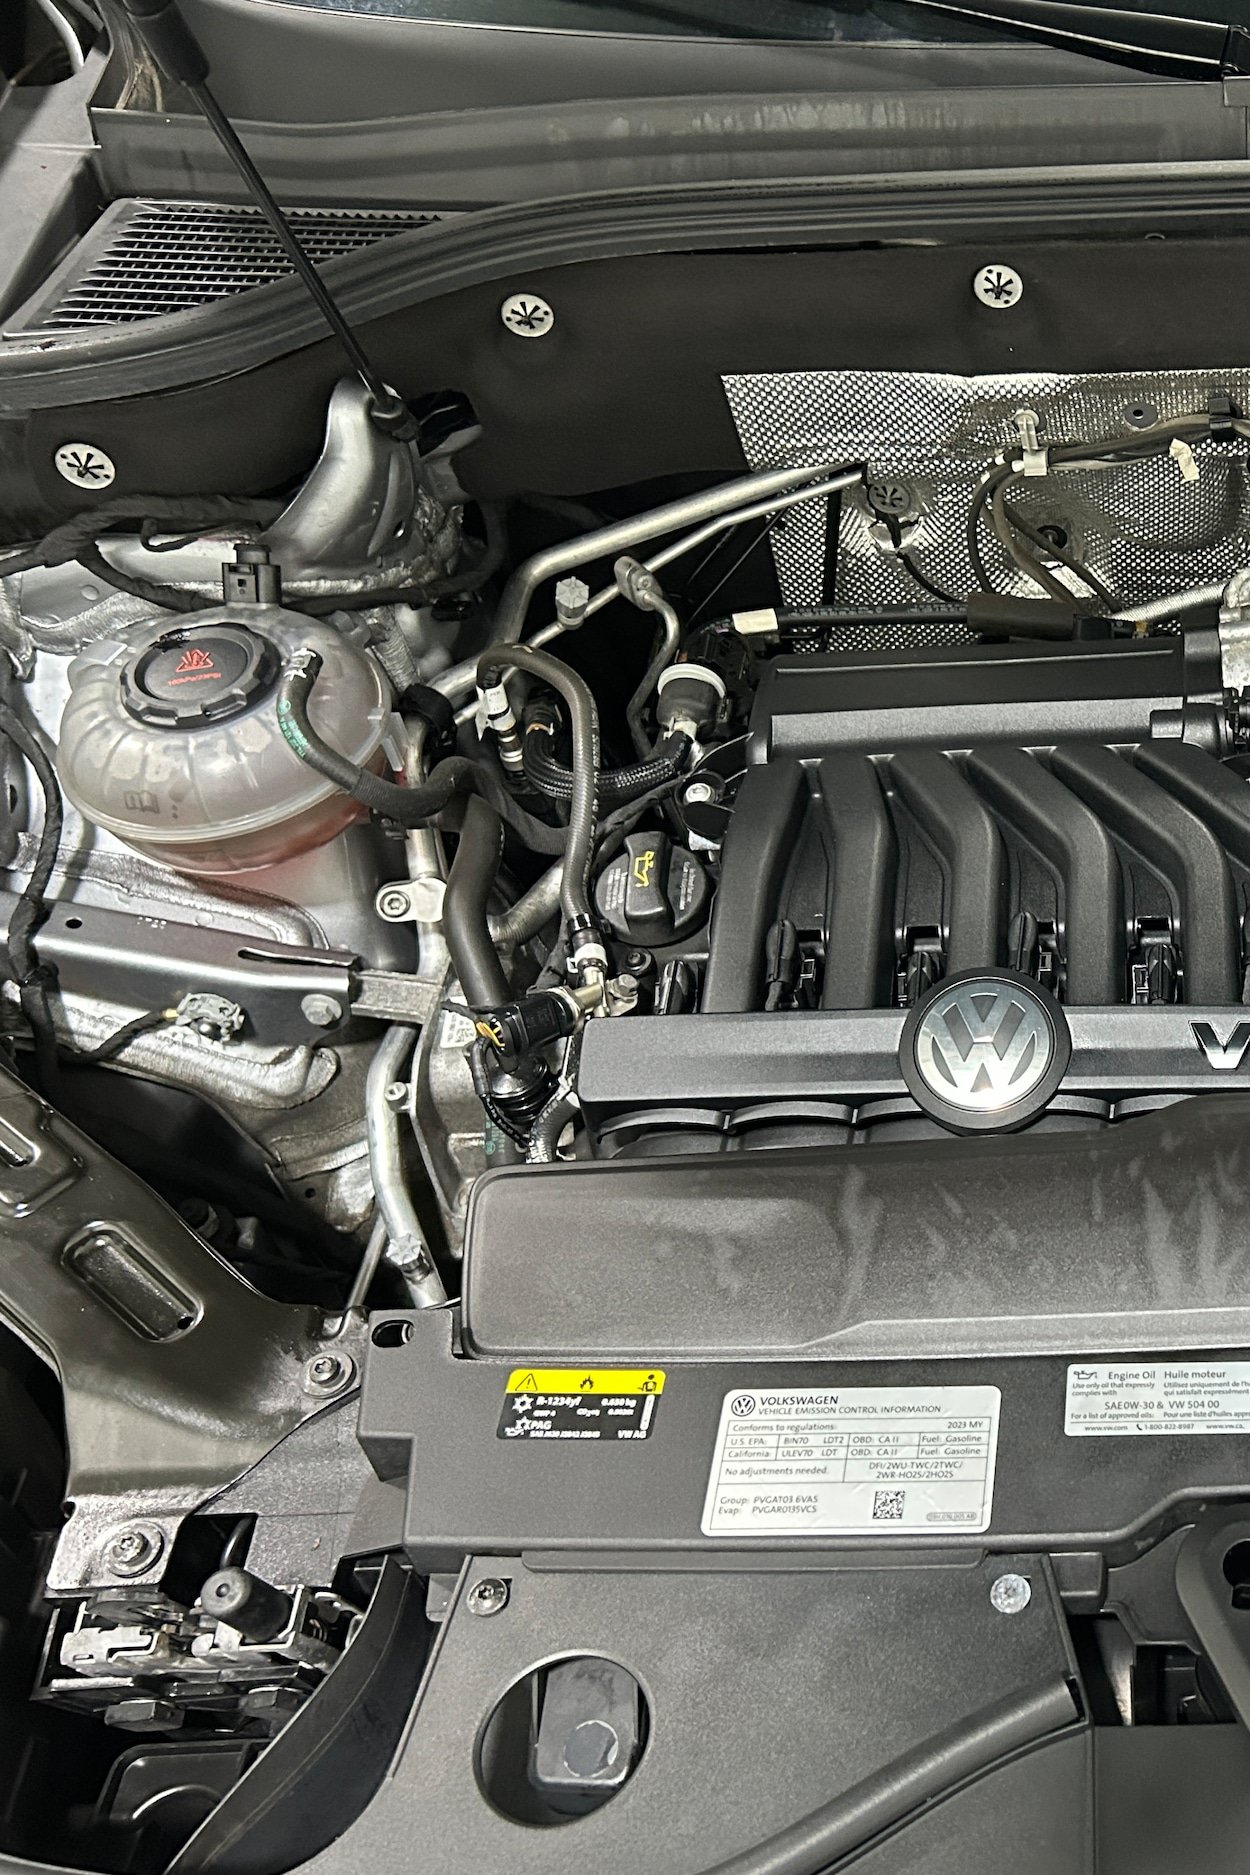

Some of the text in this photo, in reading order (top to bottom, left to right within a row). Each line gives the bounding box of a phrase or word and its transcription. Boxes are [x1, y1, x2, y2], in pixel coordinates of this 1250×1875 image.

[1108, 1370, 1156, 1381] Engine Oil
[1164, 1370, 1226, 1378] Huile moteur
[1086, 1382, 1100, 1390] only
[1190, 1381, 1230, 1389] uniquement
[1176, 1388, 1202, 1396] satisfait
[1203, 1388, 1250, 1396] expressément
[536, 1396, 582, 1408] R-1234yf
[626, 1398, 637, 1408] kg
[760, 1396, 838, 1406] VOLKSWAGEN
[1169, 1400, 1185, 1409] VW
[1188, 1400, 1205, 1408] 504
[1208, 1400, 1220, 1408] 00
[795, 1406, 836, 1414] EMISSION
[838, 1406, 878, 1414] CONTROL
[880, 1406, 941, 1414] INFORMATION
[1108, 1412, 1140, 1420] approved
[530, 1420, 552, 1430] PAG
[732, 1424, 774, 1432] Conforms
[618, 1430, 634, 1438] VW
[634, 1430, 648, 1438] AG
[823, 1436, 844, 1444] LDT2
[878, 1436, 892, 1444] CA
[782, 1449, 814, 1457] ULEV70
[821, 1448, 838, 1456] LDT
[876, 1448, 890, 1456] CA
[944, 1447, 981, 1455] Gasoline
[740, 1466, 794, 1478] adjustments
